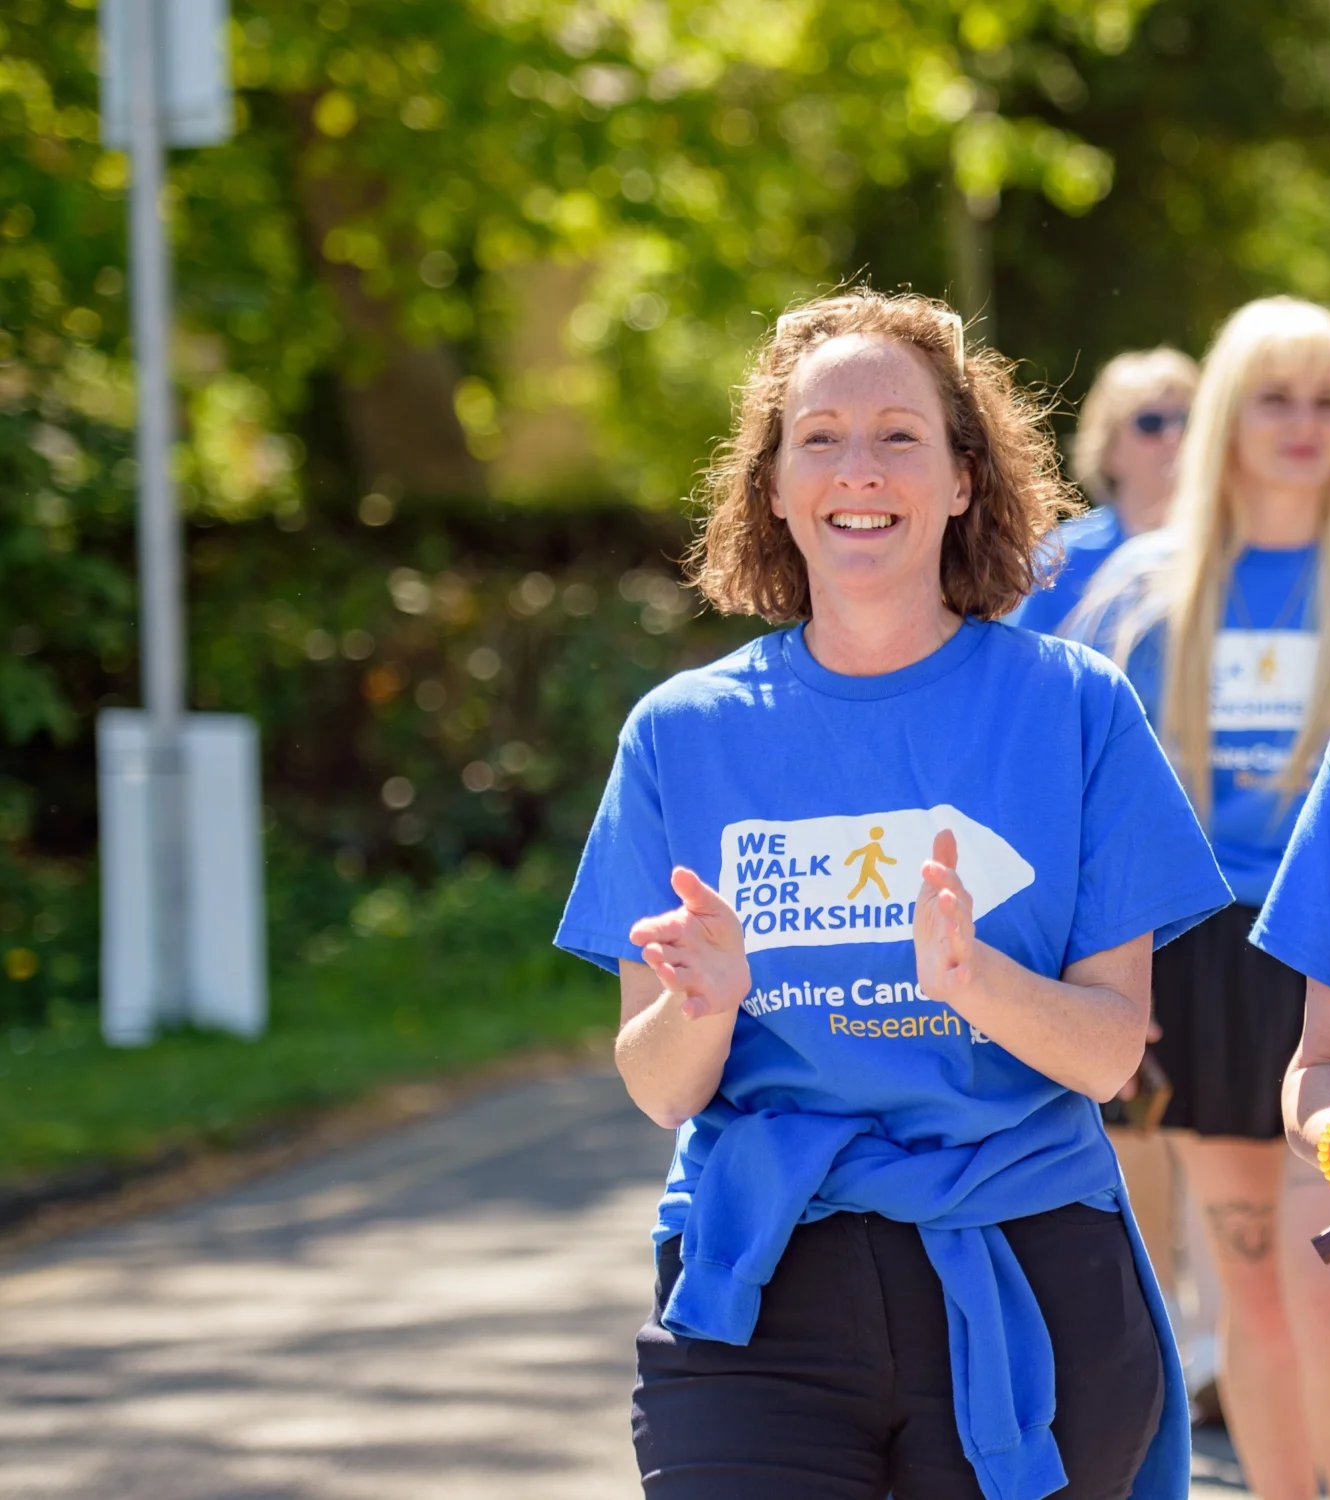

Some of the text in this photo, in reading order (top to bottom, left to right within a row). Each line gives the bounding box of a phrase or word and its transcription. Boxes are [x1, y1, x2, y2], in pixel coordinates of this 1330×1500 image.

[738, 833, 786, 856] WE
[736, 855, 832, 884] WALK
[735, 881, 800, 912] FOR
[829, 1010, 961, 1038] Research
